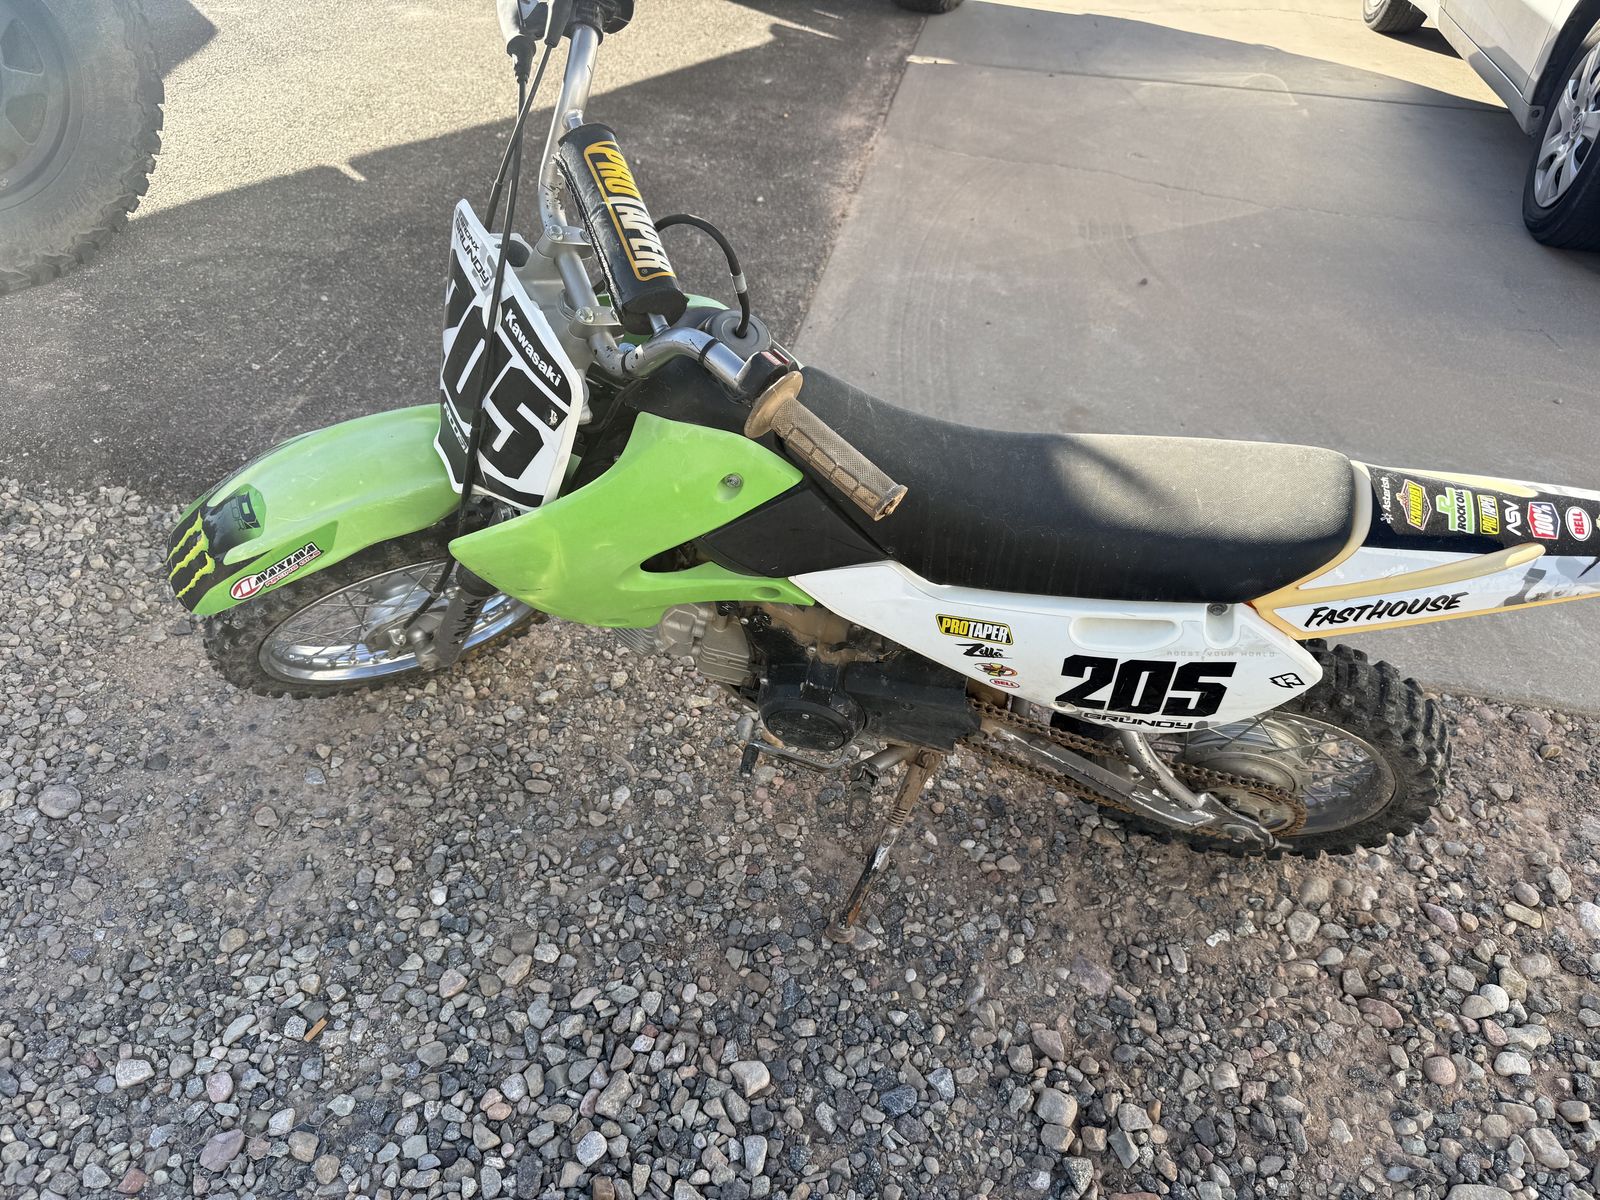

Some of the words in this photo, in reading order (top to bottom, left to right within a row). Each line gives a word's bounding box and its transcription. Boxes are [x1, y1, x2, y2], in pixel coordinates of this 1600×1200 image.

[505, 308, 562, 387] Kawasaki
[1456, 491, 1465, 506] OIL
[1457, 506, 1467, 530] ROCK
[1503, 499, 1522, 536] ASV
[1531, 504, 1555, 535] 100%
[1572, 511, 1585, 535] BELL
[254, 542, 318, 586] MAXIMA
[1304, 591, 1469, 628] FASTHOUSE
[941, 617, 1008, 643] PROTAPER
[1054, 654, 1237, 717] 205
[1083, 712, 1193, 729] GRUNDY
